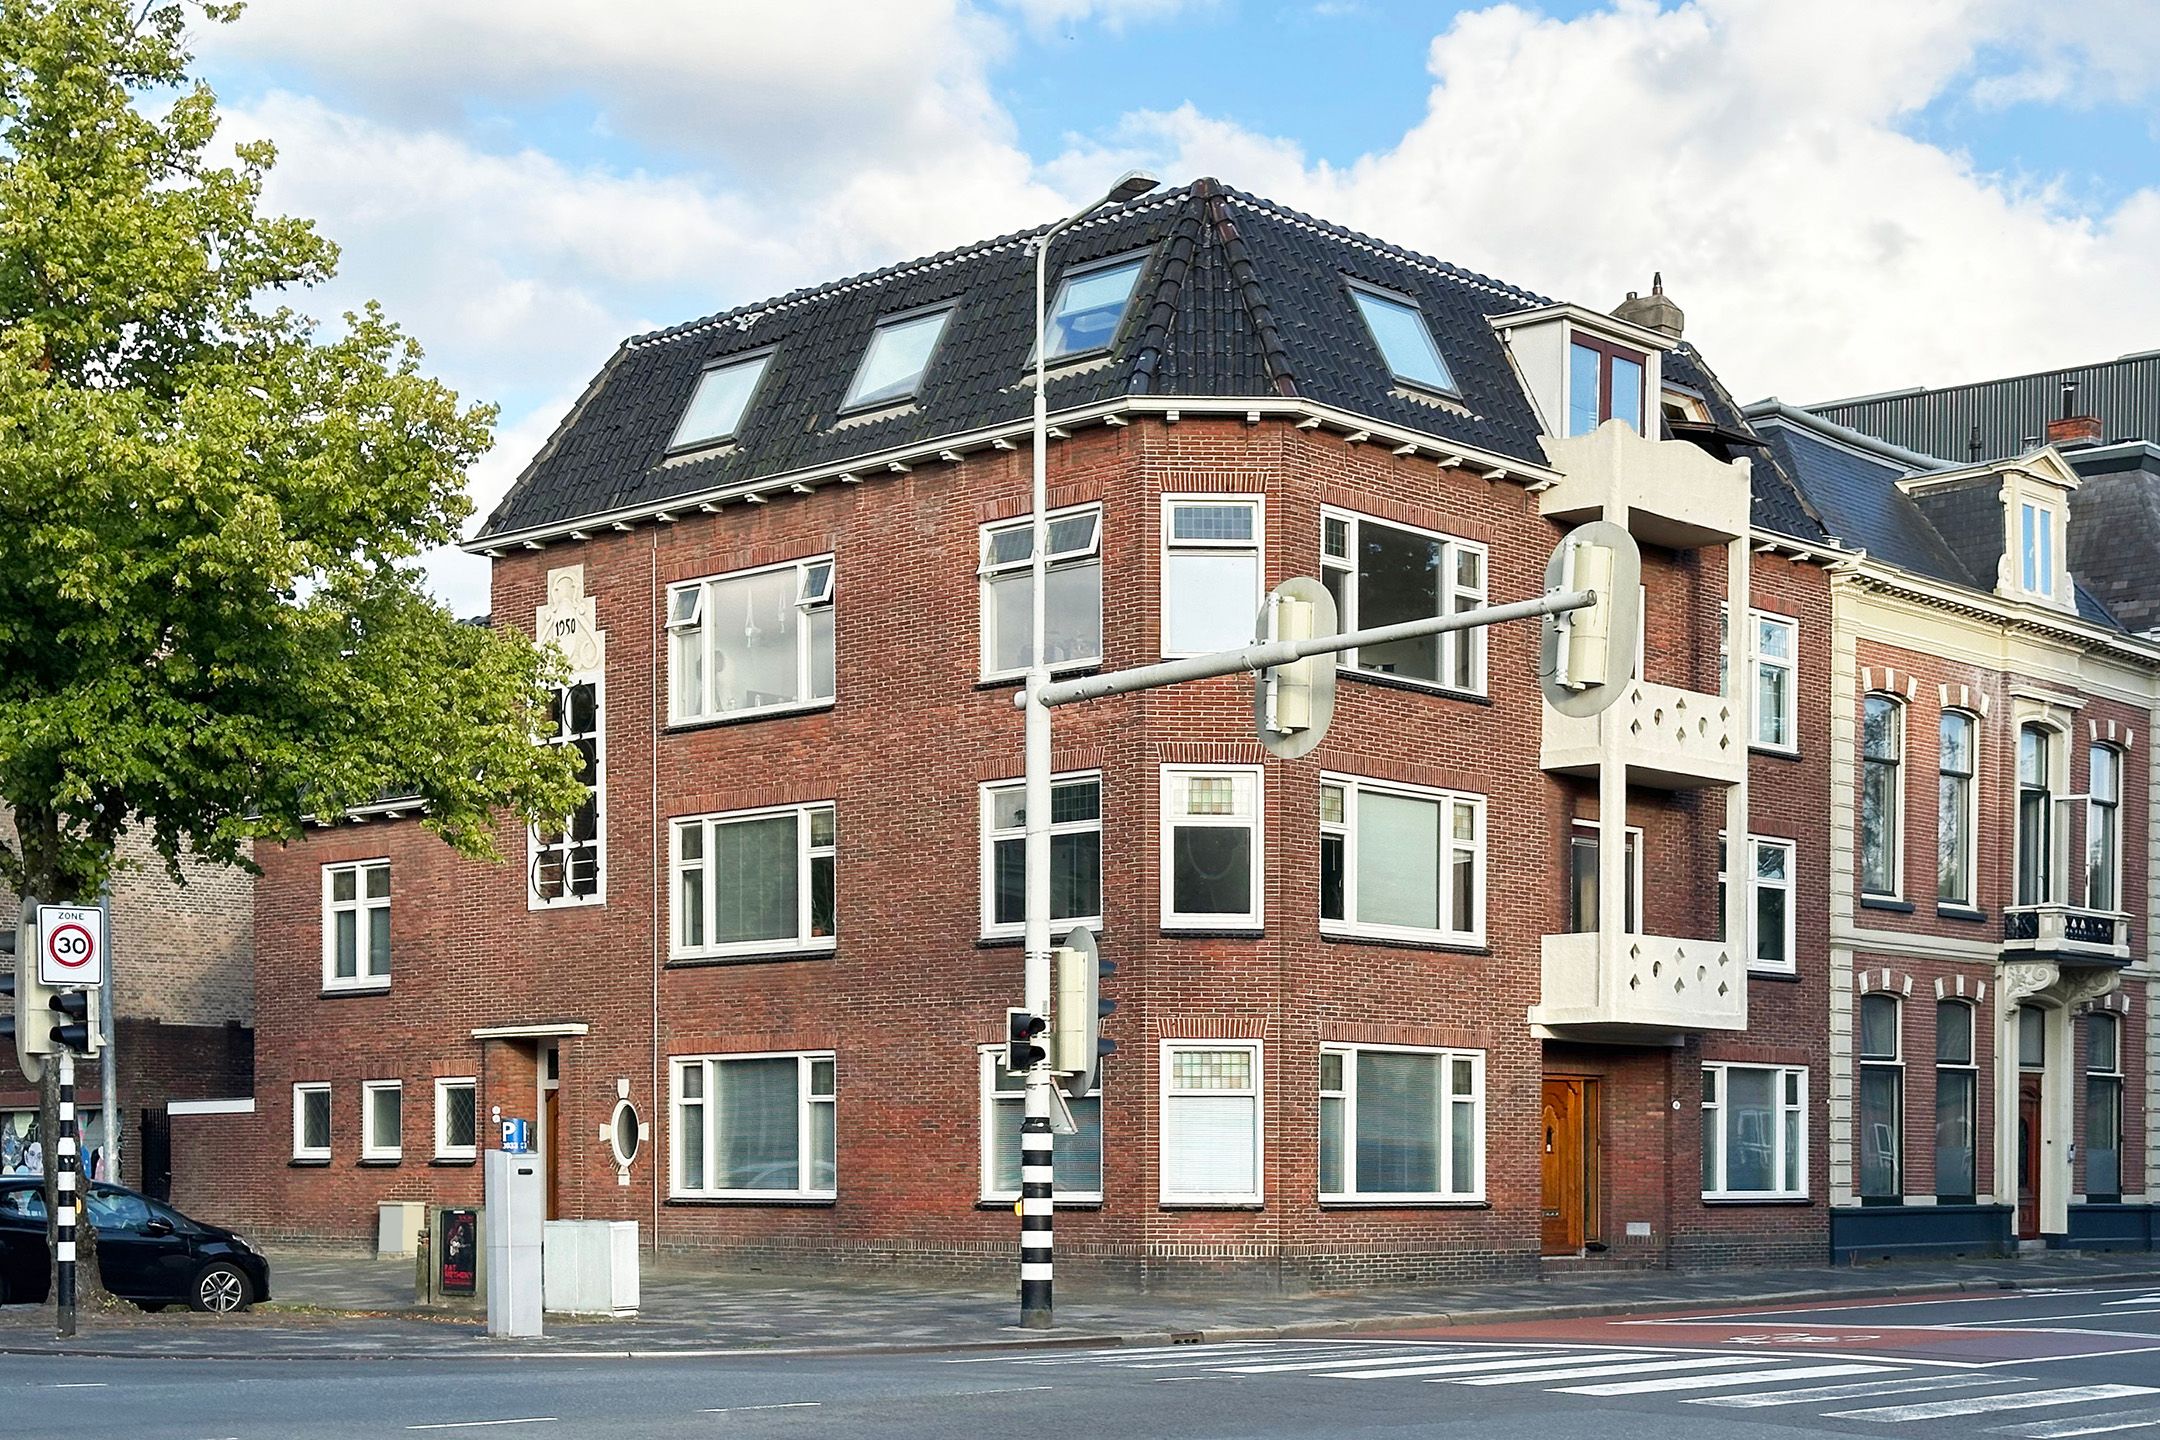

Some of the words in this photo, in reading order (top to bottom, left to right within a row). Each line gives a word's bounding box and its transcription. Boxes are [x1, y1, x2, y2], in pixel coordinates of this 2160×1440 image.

[555, 617, 576, 637] 1950
[58, 911, 85, 921] ZONE
[57, 936, 87, 955] 30
[502, 1121, 517, 1142] P
